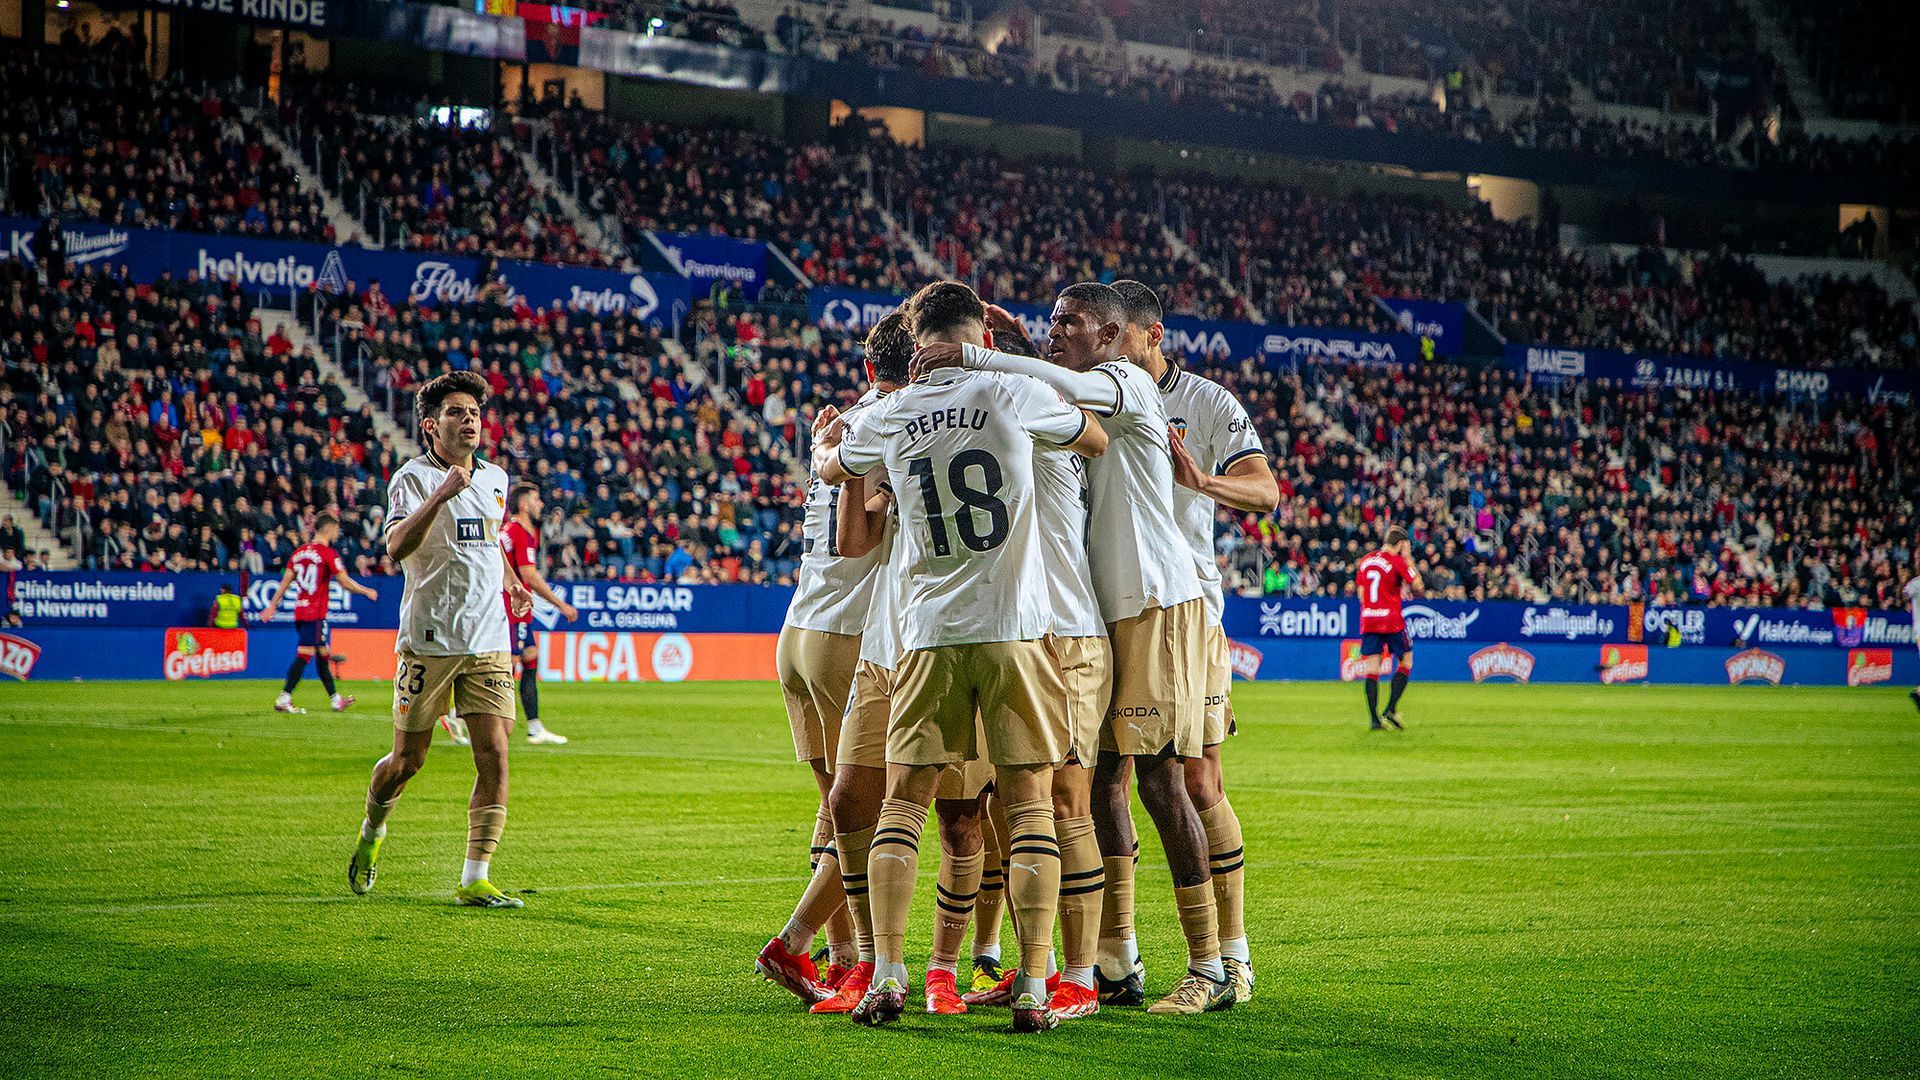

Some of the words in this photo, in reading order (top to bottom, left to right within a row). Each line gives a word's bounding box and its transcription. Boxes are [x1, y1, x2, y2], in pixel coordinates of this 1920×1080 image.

[0, 230, 37, 264] K
[198, 249, 315, 287] helvetia
[905, 407, 989, 443] PEPELU
[907, 448, 1010, 558] 18
[460, 523, 480, 537] TM
[14, 580, 73, 600] Clínica
[74, 580, 175, 601] Universidad
[572, 585, 604, 610] EL
[606, 586, 694, 612] SADAR
[1366, 570, 1381, 603] 7
[36, 601, 108, 618] Navarra
[1281, 602, 1348, 636] enhol
[0, 638, 34, 676] ZO
[166, 648, 245, 680] Grefusa
[538, 631, 641, 683] LIGA
[397, 661, 427, 695] 23
